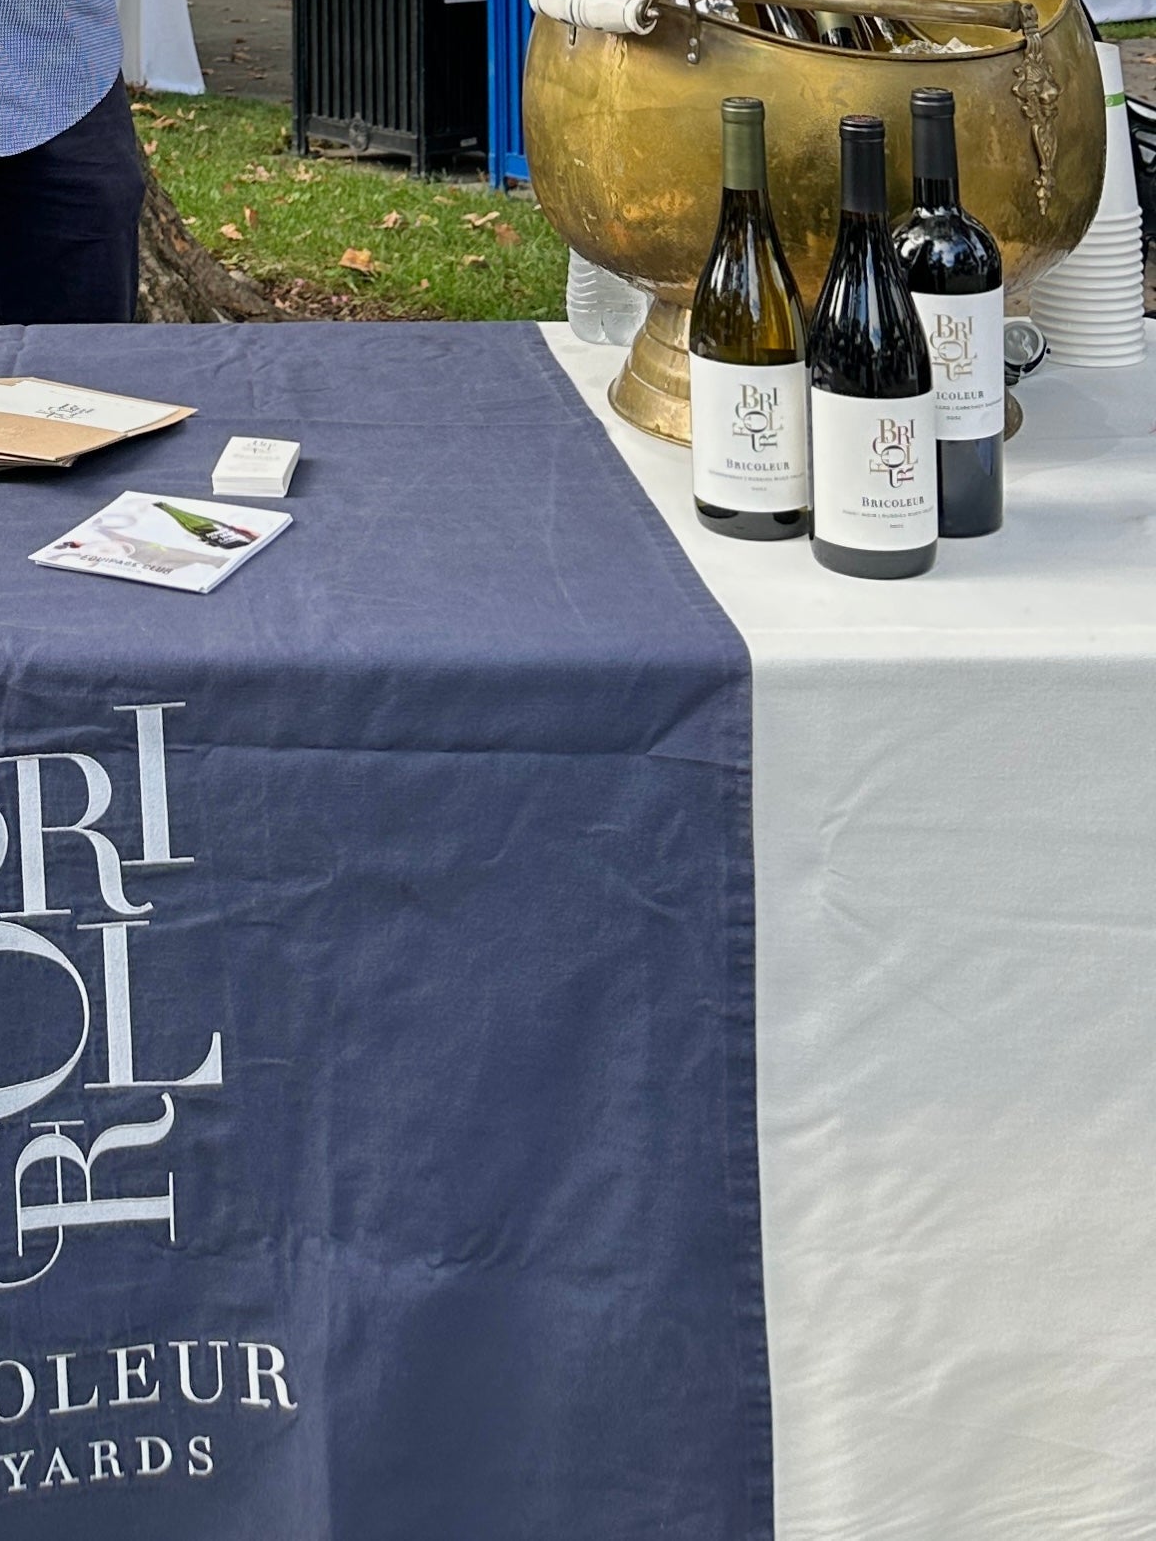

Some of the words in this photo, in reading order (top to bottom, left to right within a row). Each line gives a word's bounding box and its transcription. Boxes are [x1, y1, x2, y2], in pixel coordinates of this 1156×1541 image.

[726, 458, 790, 471] BRICOLEUR
[862, 495, 925, 508] BRICOLEUR
[80, 554, 141, 568] EQUIPAGE
[142, 563, 175, 575] CLUB
